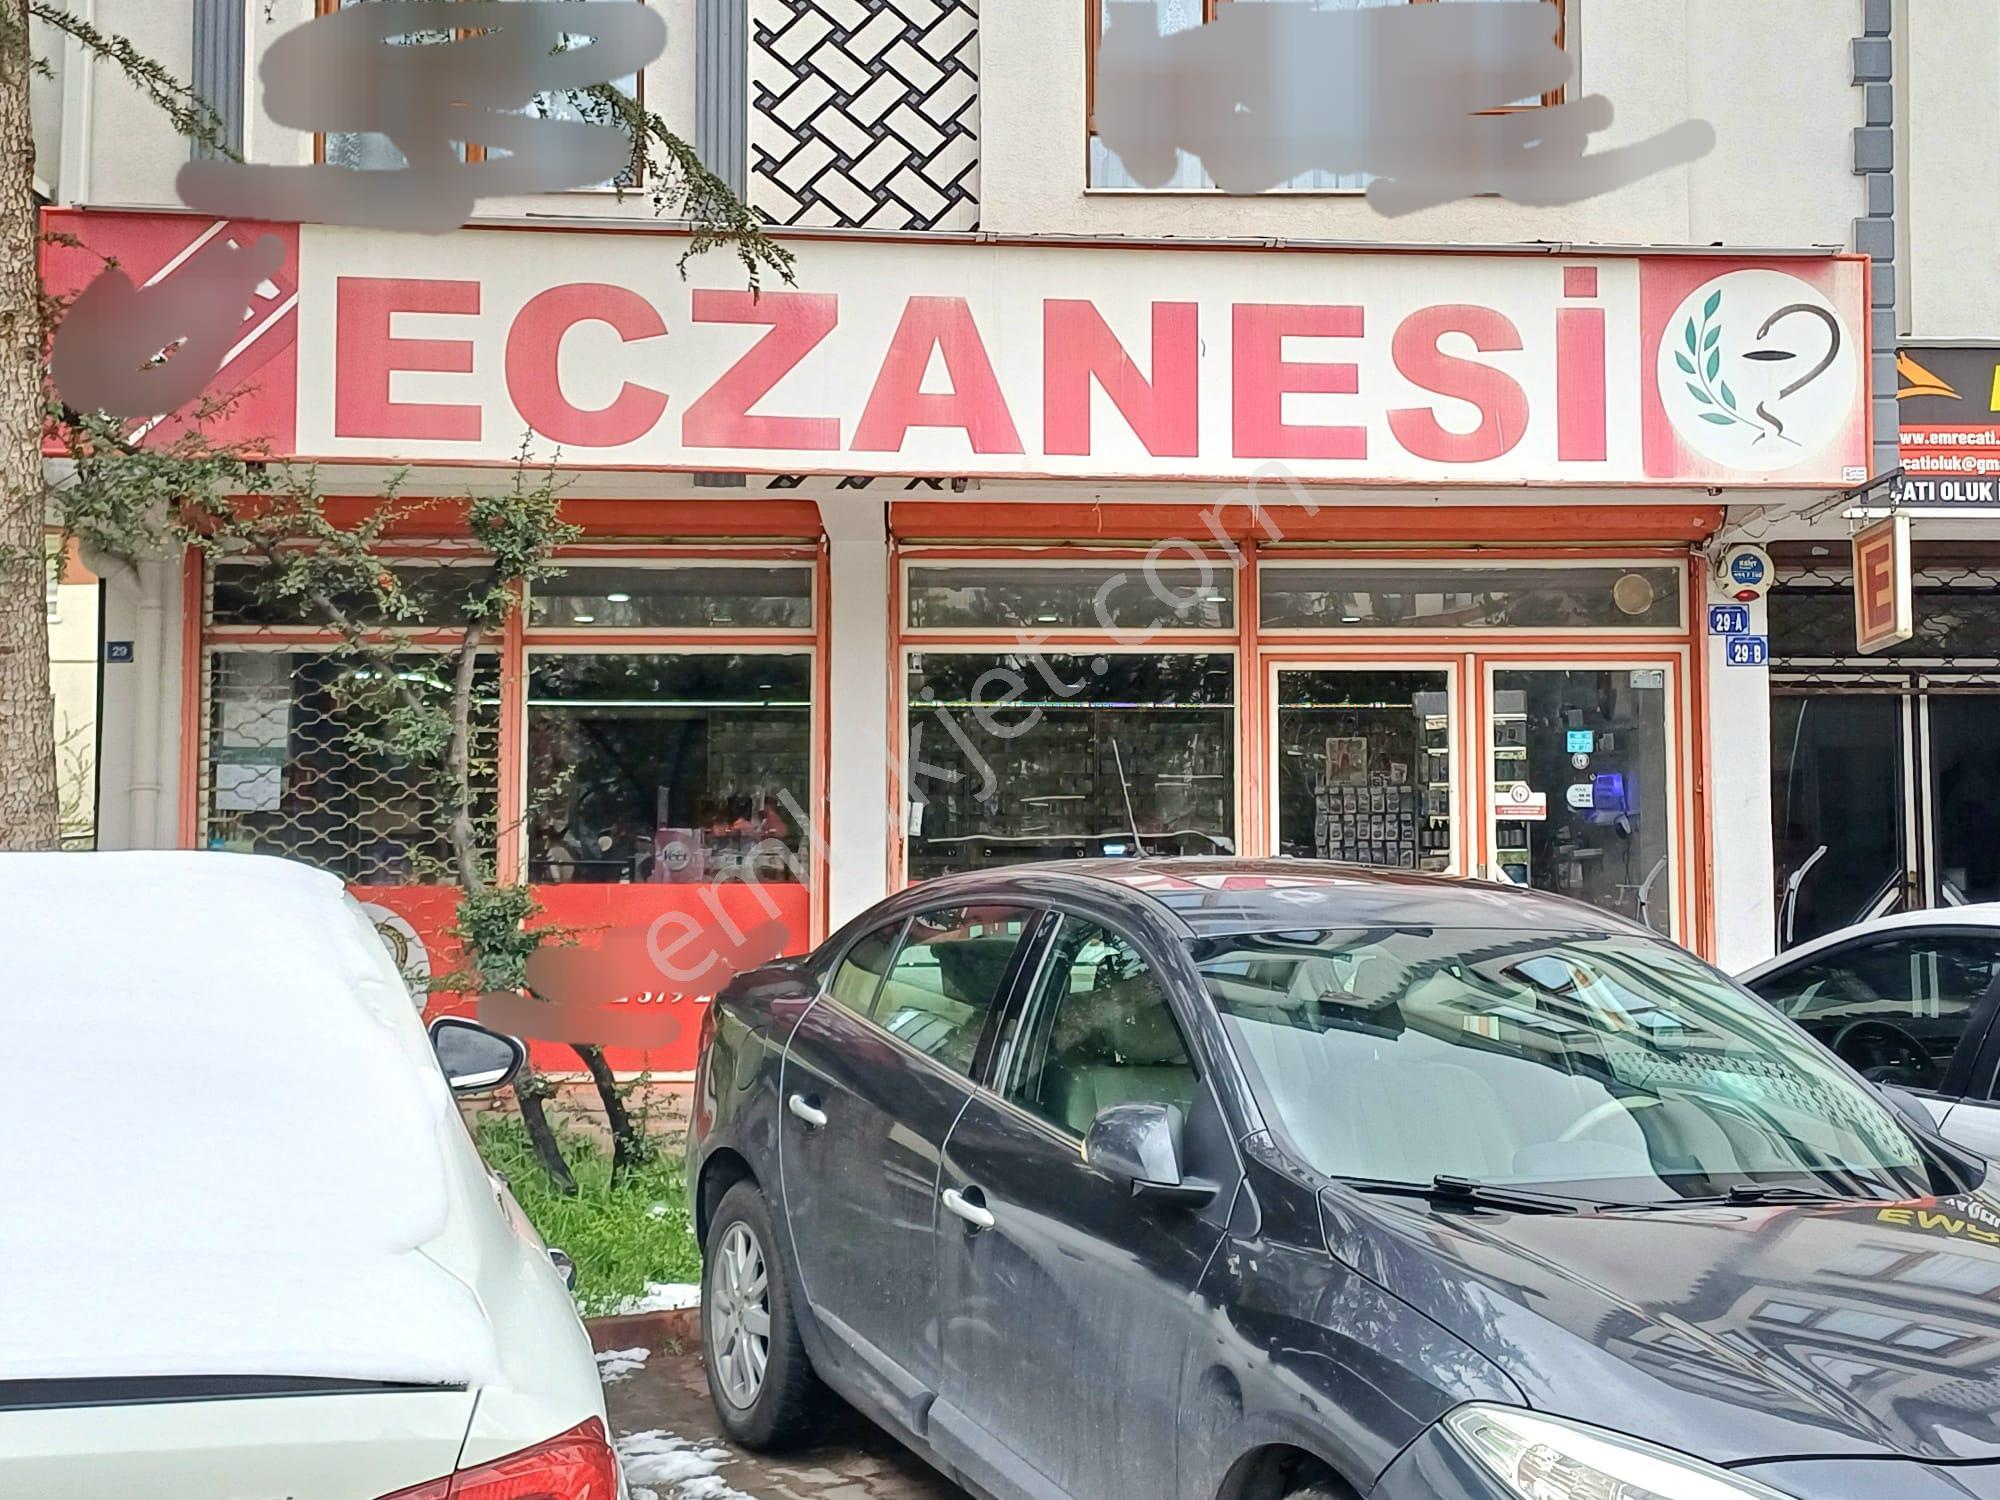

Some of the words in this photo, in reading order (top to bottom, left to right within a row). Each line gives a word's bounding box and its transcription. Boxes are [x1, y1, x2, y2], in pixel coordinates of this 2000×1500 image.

[335, 266, 1607, 461] ECZANESİ
[1940, 481, 1993, 501] OLUK
[1866, 543, 1892, 629] E
[1716, 612, 1742, 631] 29-A
[112, 646, 128, 657] 29
[1734, 644, 1761, 663] 29-B
